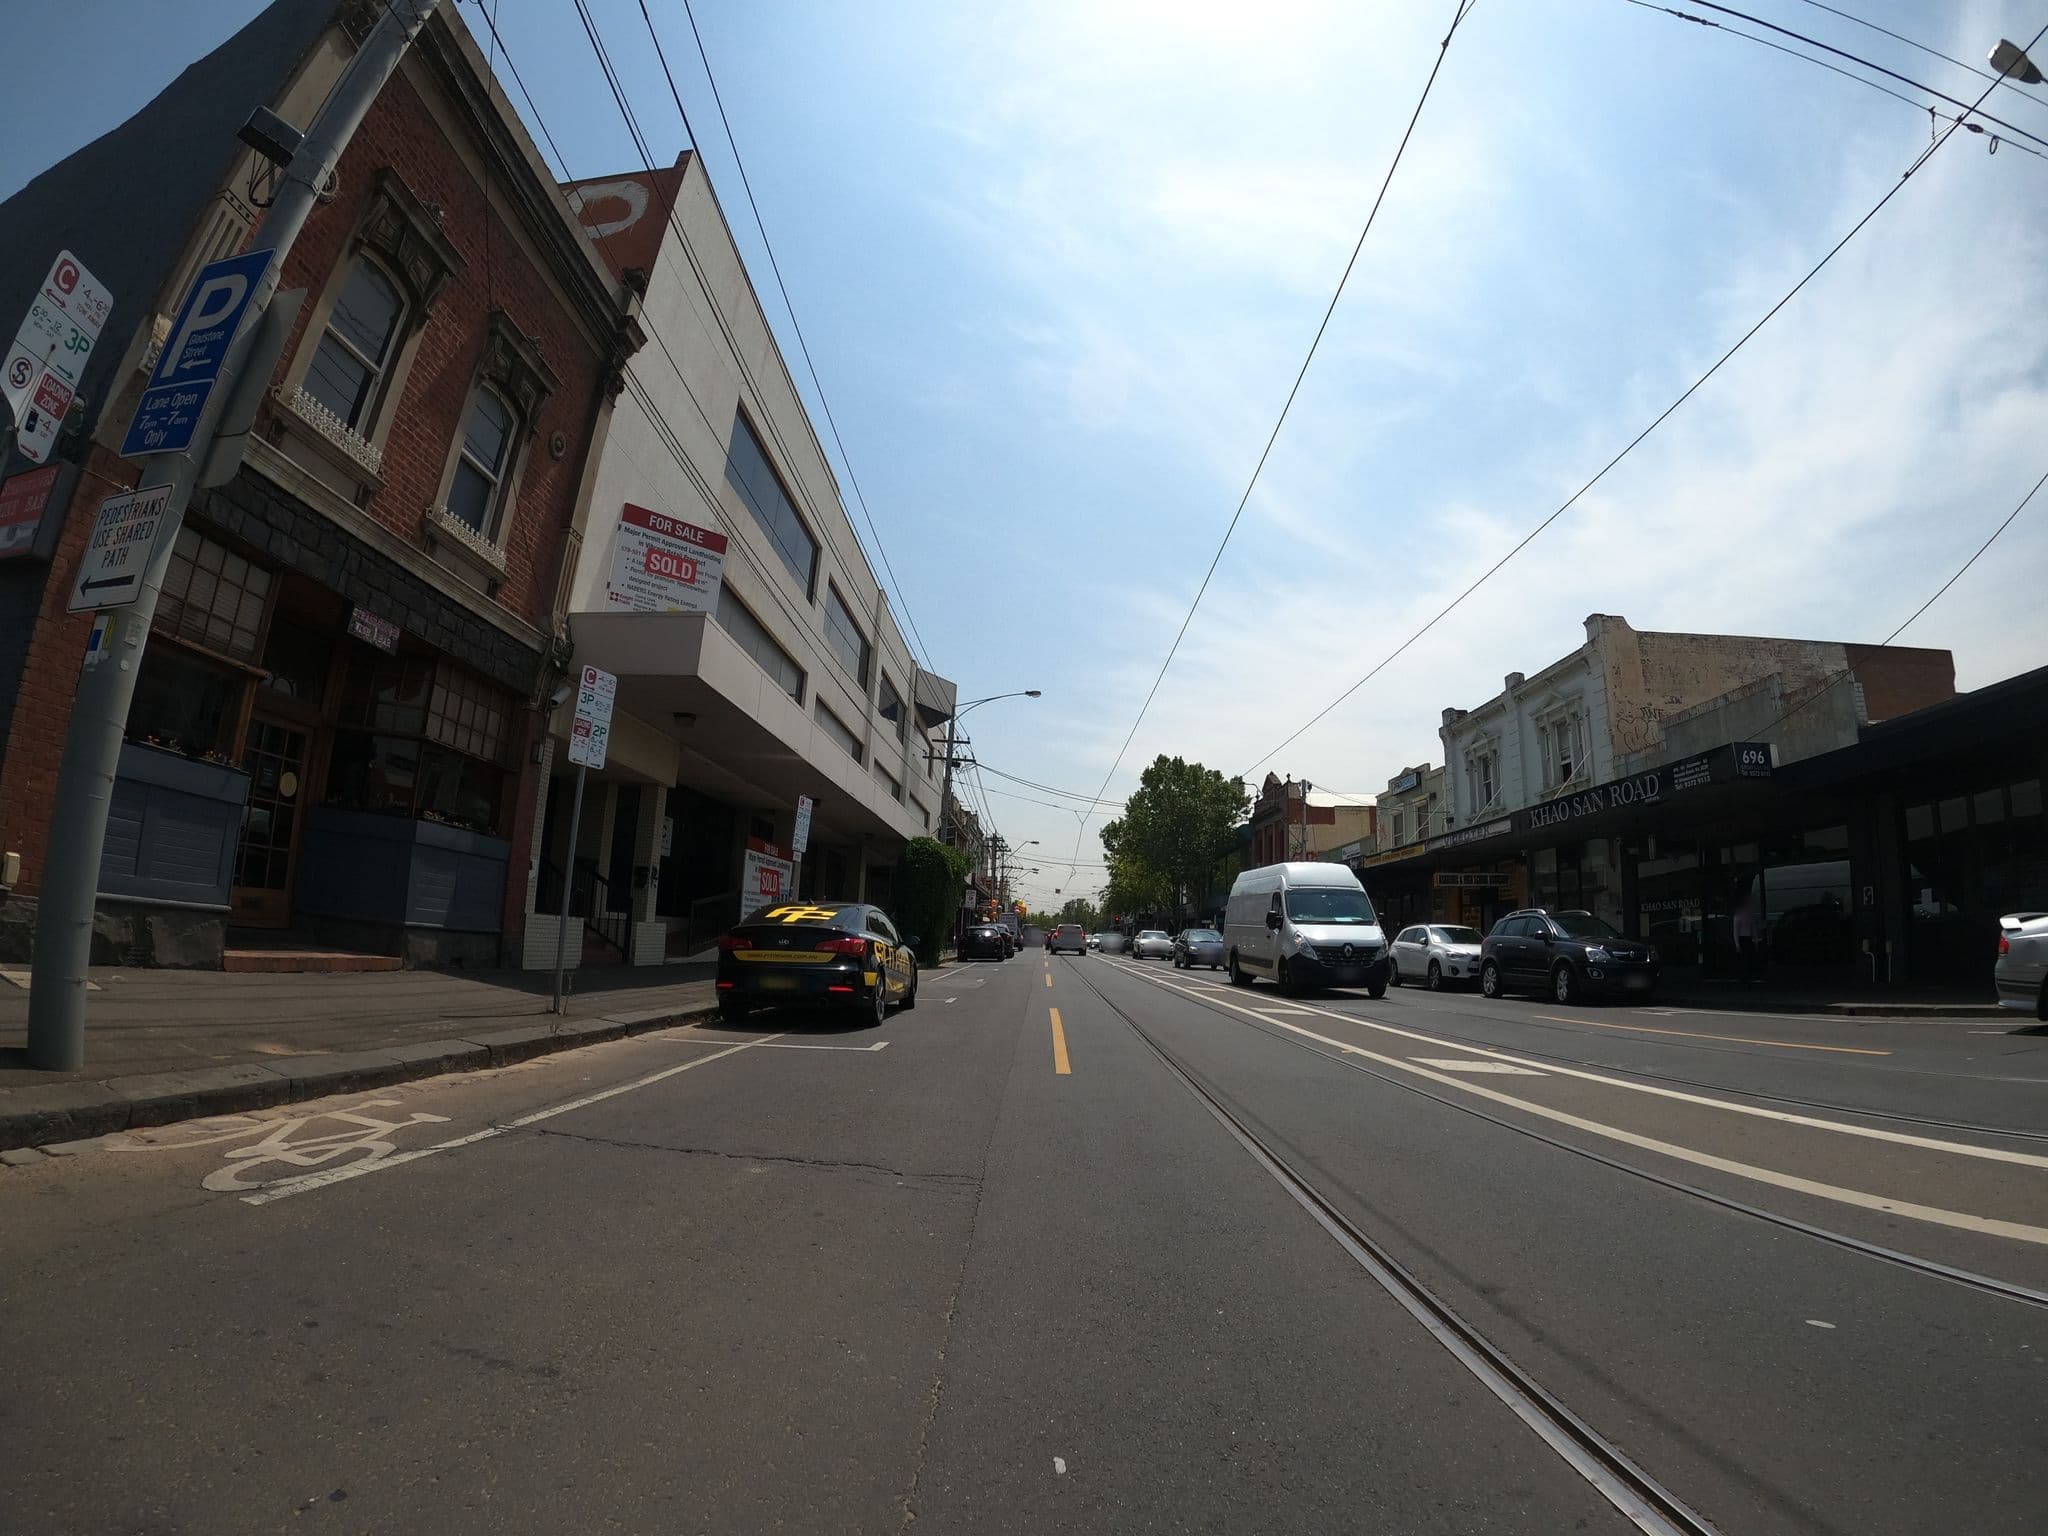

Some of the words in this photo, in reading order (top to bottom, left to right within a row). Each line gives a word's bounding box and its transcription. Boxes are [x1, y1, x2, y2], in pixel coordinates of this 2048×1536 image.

[59, 265, 76, 290] C
[160, 273, 248, 378] P
[64, 328, 90, 354] 3P
[188, 330, 224, 346] Gladstone
[183, 345, 207, 359] Street
[42, 374, 71, 403] LOADING
[40, 394, 60, 415] ZONE
[145, 397, 170, 411] Lane
[171, 393, 198, 409] Open
[144, 430, 168, 447] Only
[98, 497, 165, 527] PEDESTRIANS
[93, 528, 113, 549] USE
[113, 521, 154, 545] SHARED
[649, 514, 673, 533] FOR
[674, 523, 705, 544] SALE
[101, 546, 130, 569] PATH
[623, 527, 641, 538] Major
[642, 532, 661, 544] Permit
[661, 539, 688, 554] Approved
[688, 547, 722, 565] Landholding
[649, 553, 692, 580] SOLD
[647, 590, 664, 601] Energy
[580, 692, 595, 705] 3P
[592, 725, 607, 738] 2P
[1743, 750, 1765, 765] 696
[1530, 801, 1569, 829] KHAO
[1573, 790, 1605, 817] SAN
[1609, 774, 1660, 808] ROAD
[761, 872, 778, 892] SOLD
